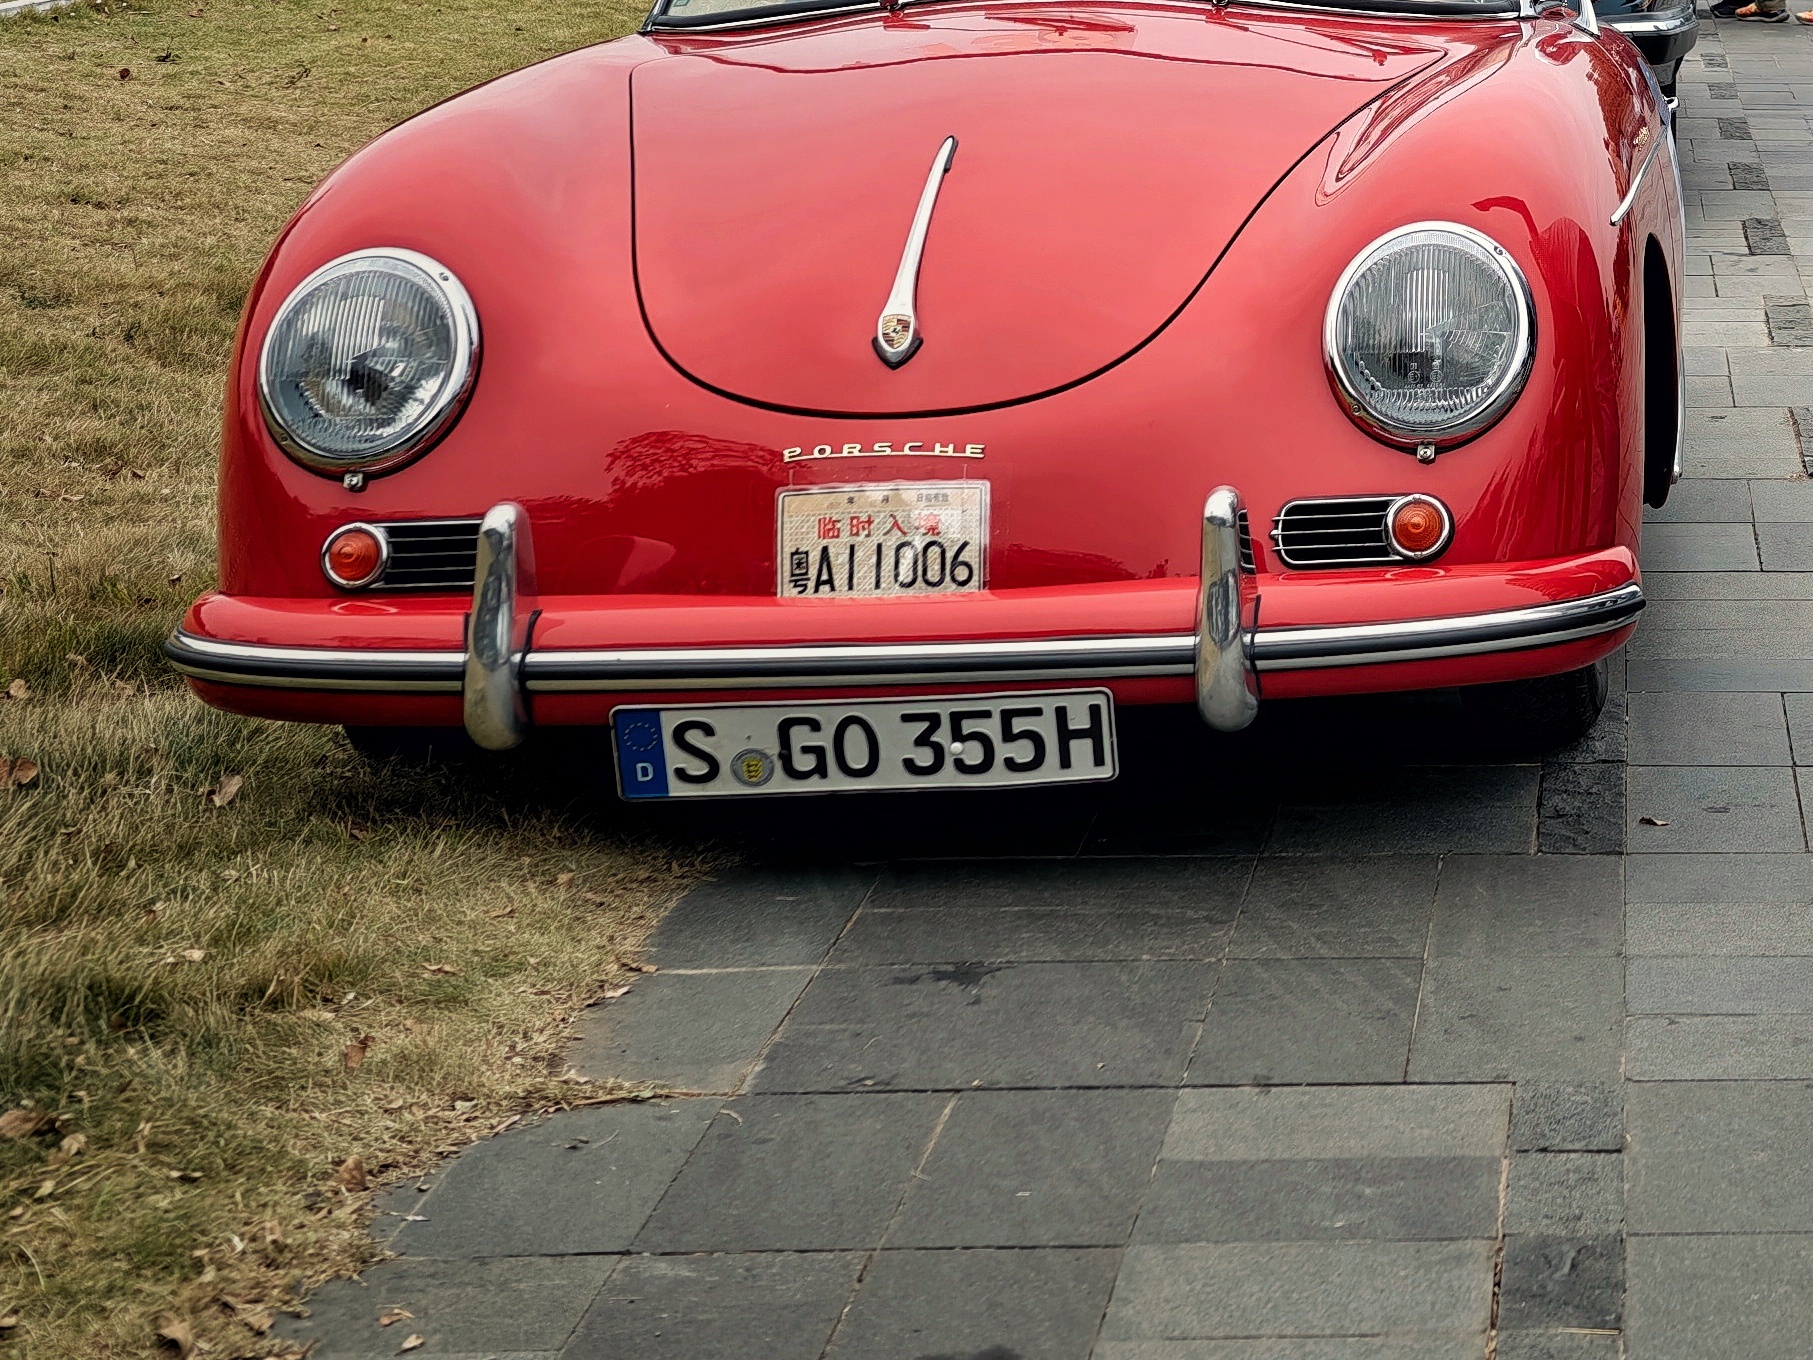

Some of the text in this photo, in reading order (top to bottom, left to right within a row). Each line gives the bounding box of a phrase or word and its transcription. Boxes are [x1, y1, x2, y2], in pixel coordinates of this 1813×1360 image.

[782, 441, 986, 463] PORSCHE
[818, 512, 942, 540] 临时入境
[671, 703, 1107, 784] S GO 355H
[636, 762, 655, 782] D
